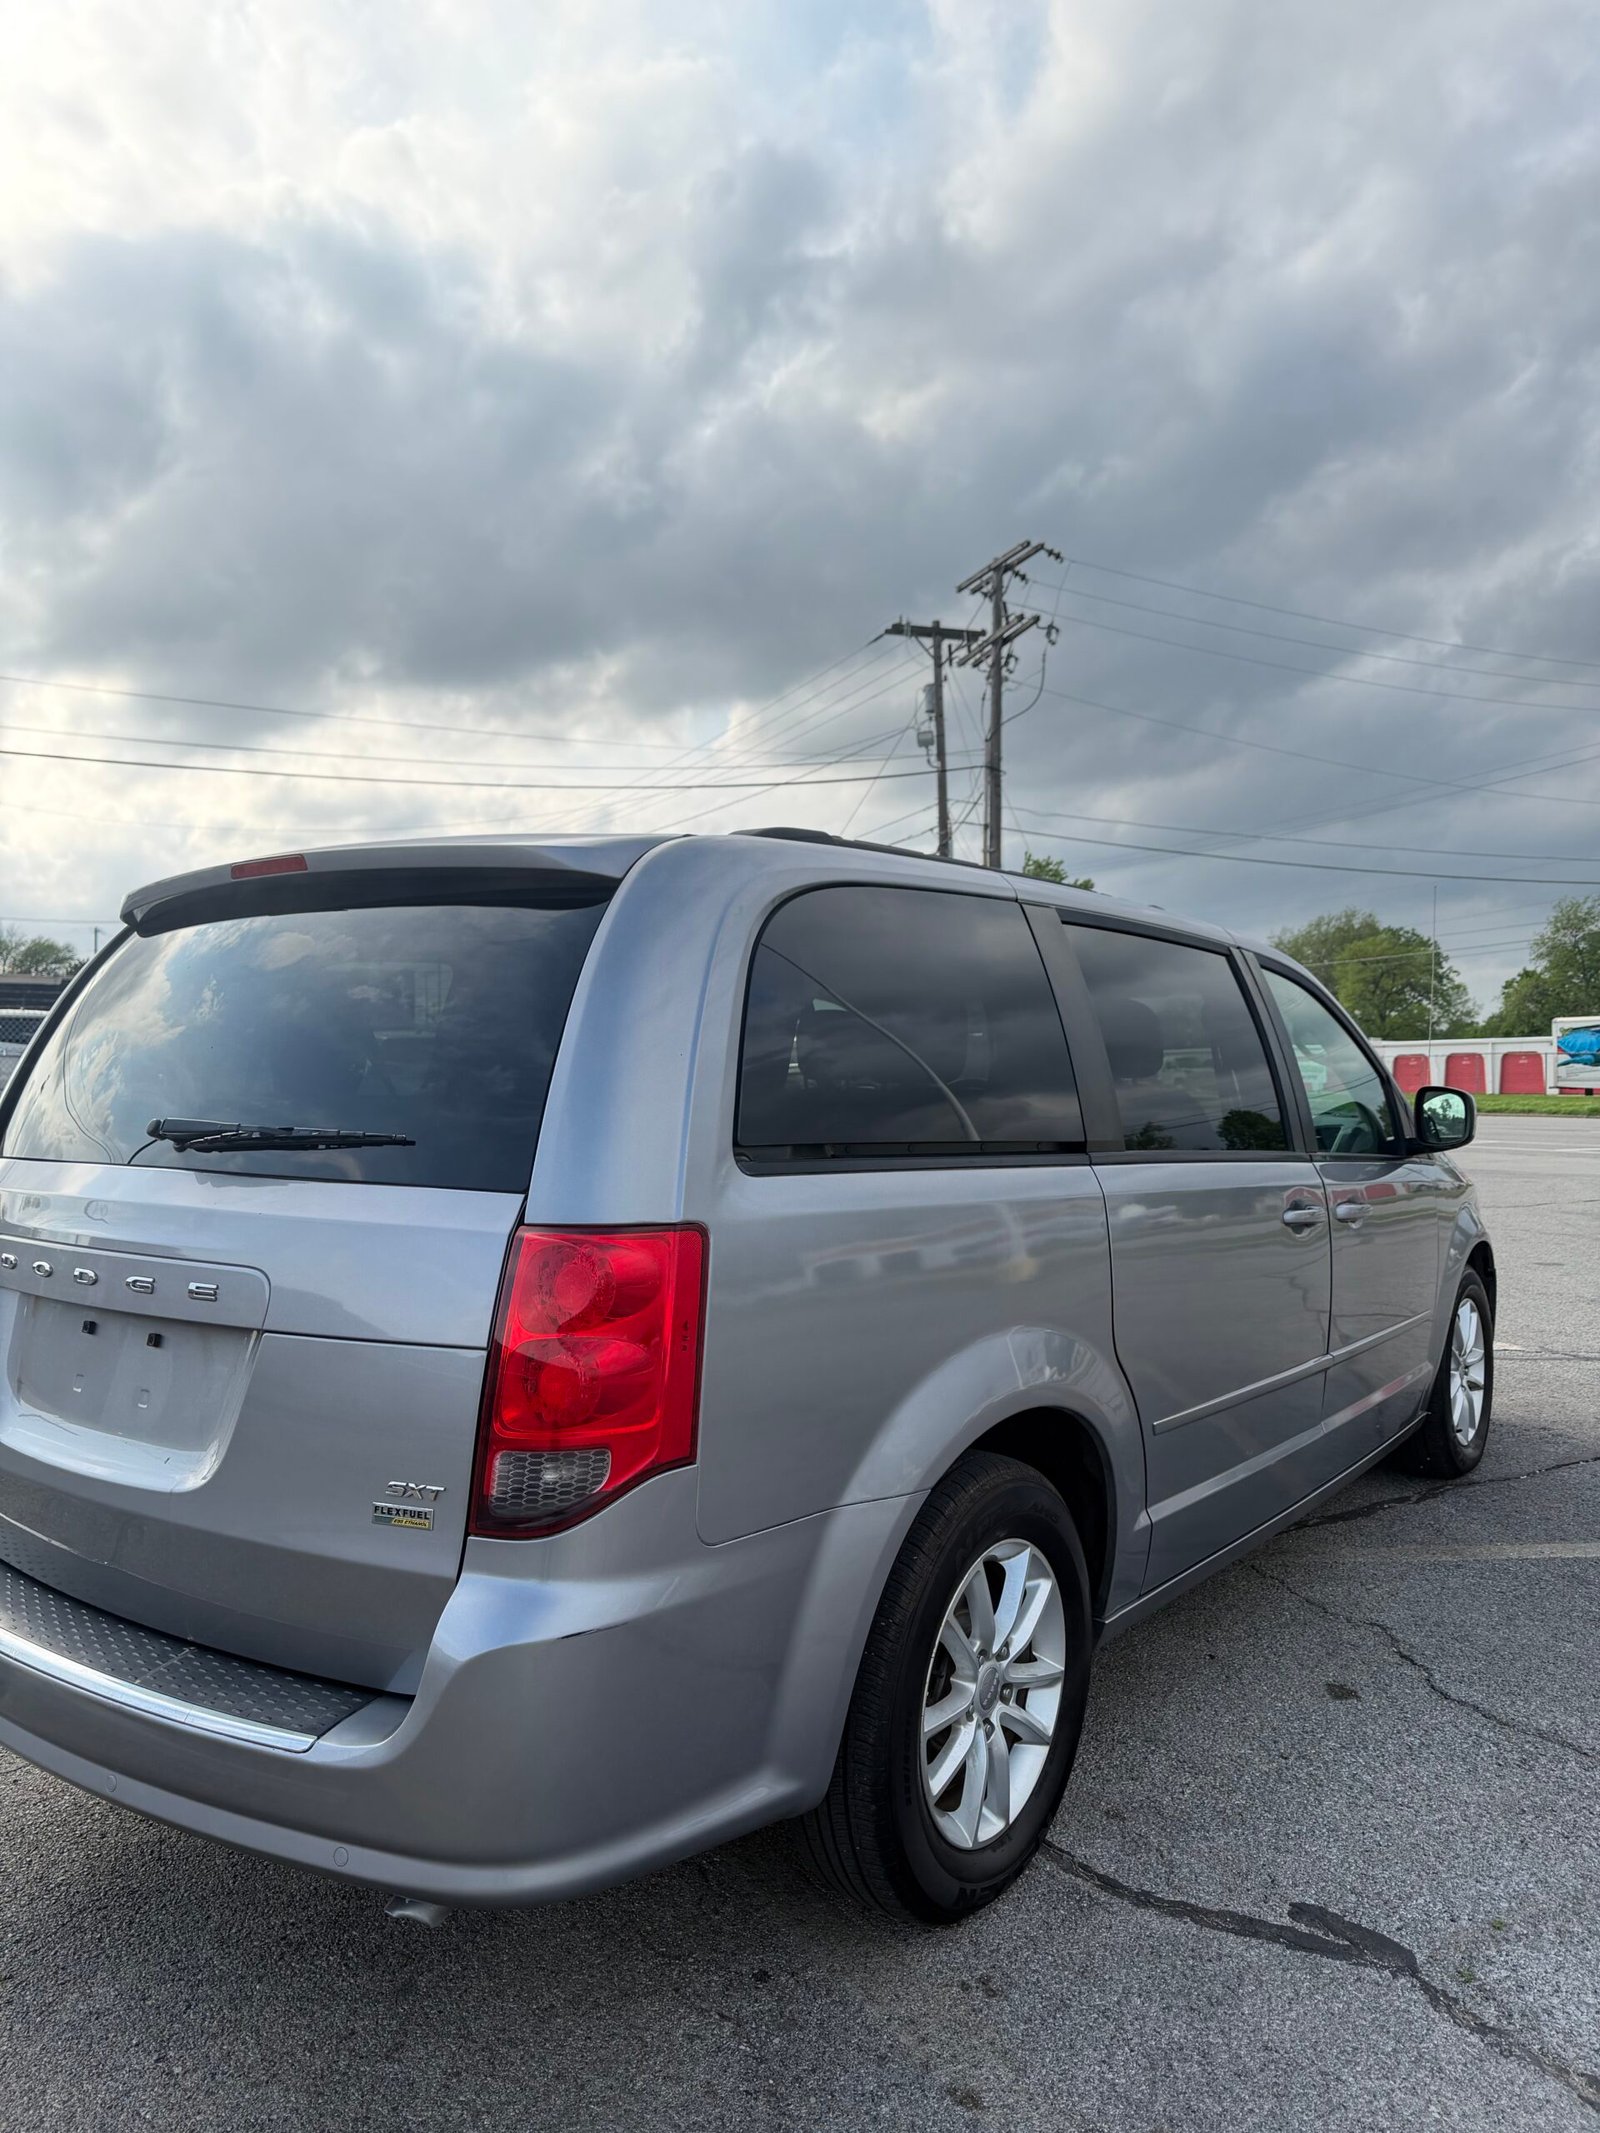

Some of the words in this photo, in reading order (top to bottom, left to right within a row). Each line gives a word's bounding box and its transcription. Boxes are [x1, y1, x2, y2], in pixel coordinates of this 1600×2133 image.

[1, 1253, 219, 1302] DODGE
[385, 1481, 446, 1501] SXT
[374, 1505, 430, 1520] FLEXFUEL
